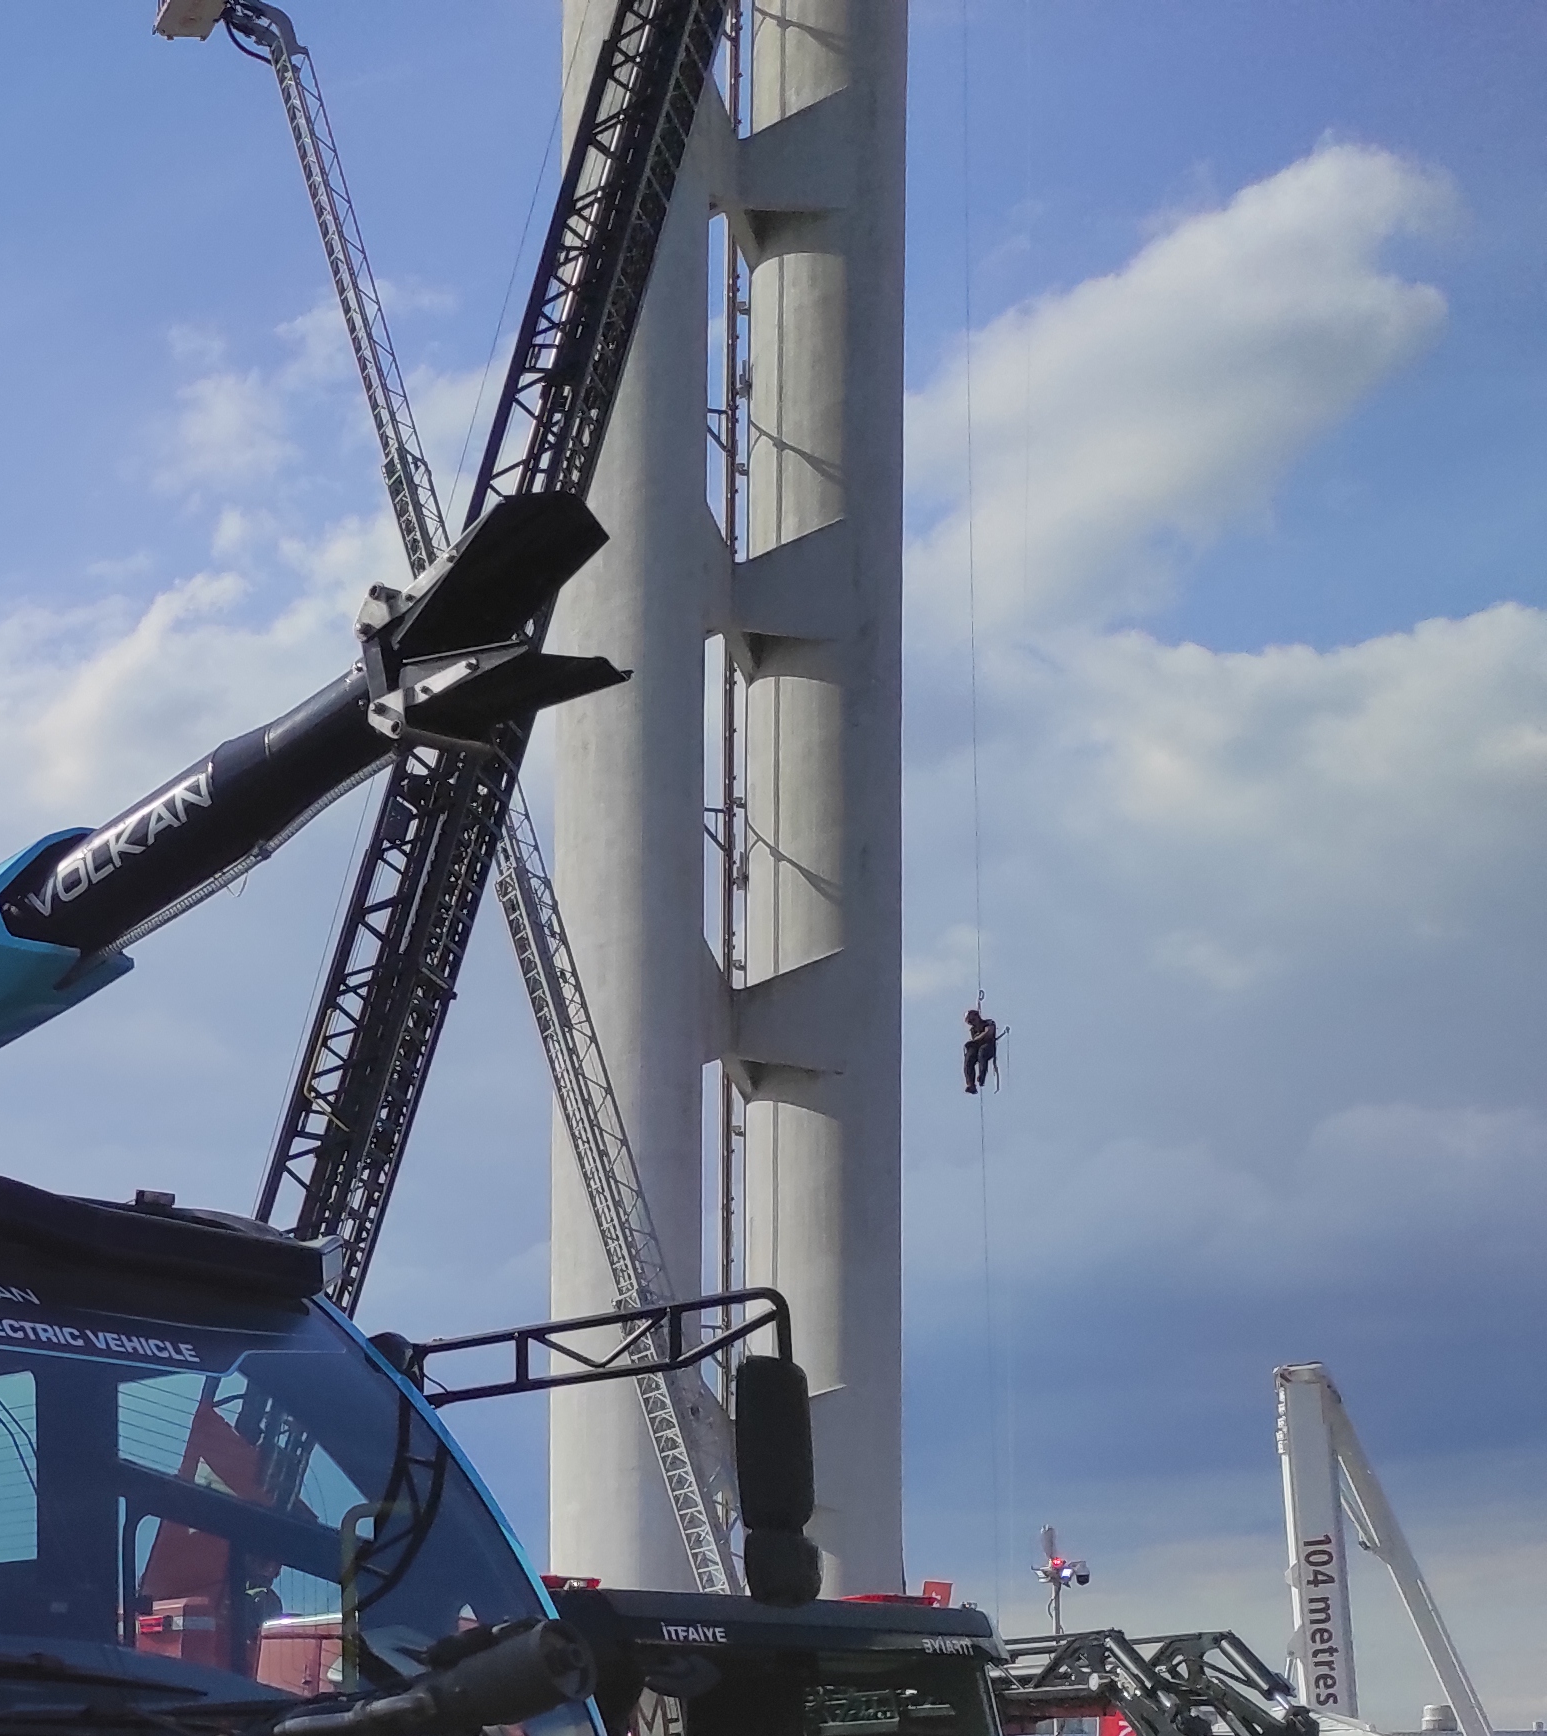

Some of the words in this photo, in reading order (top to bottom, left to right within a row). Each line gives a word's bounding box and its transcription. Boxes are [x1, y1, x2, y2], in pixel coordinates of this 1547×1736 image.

[24, 768, 213, 918] VOLKAN
[84, 1330, 201, 1363] VEHICLE
[1303, 1533, 1336, 1588] 104
[1307, 1596, 1340, 1707] metres
